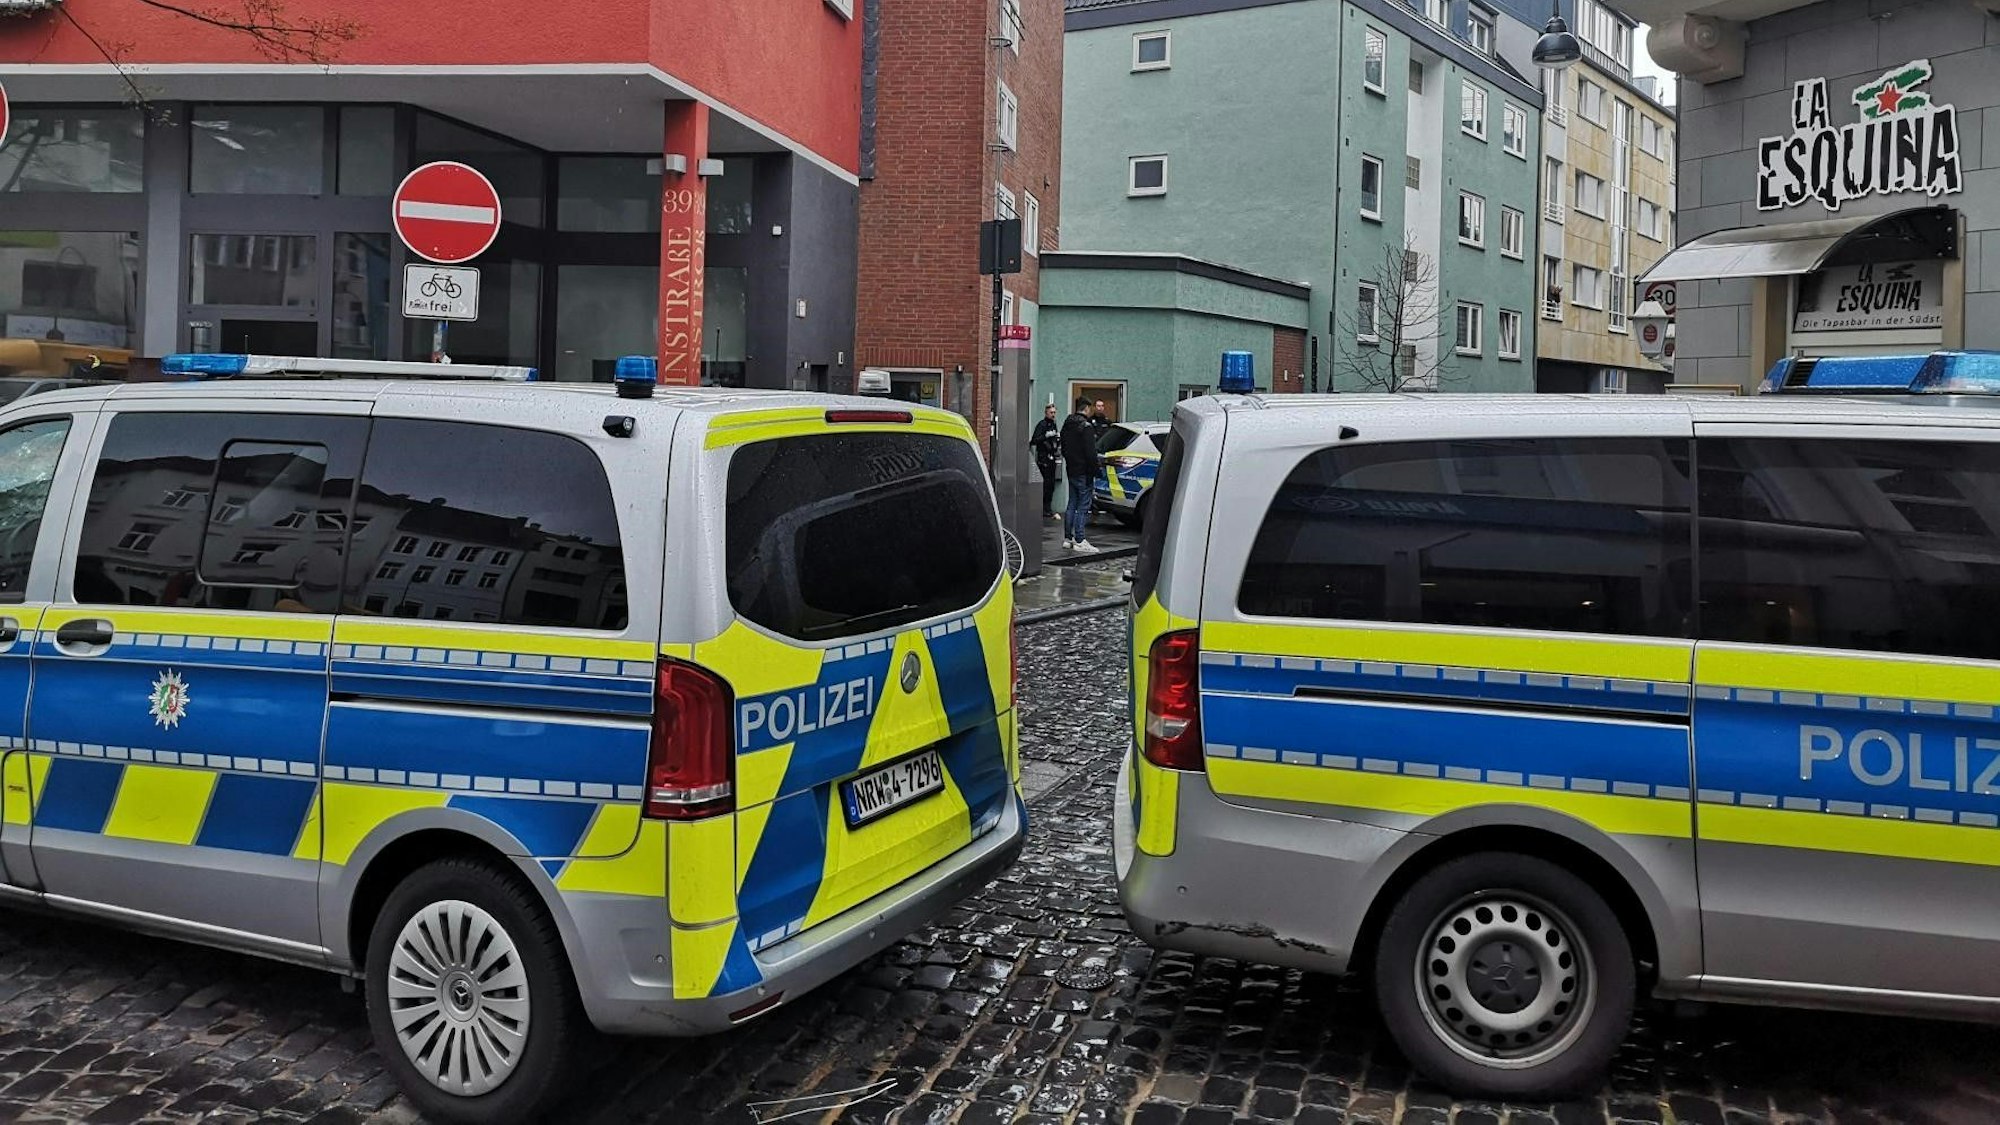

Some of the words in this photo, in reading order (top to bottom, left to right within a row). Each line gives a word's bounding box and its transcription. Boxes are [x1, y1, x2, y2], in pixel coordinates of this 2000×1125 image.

[1795, 82, 1827, 129] LA
[1759, 109, 1958, 208] ESQUINA
[663, 189, 693, 213] 39
[1857, 263, 1875, 283] LA
[430, 300, 452, 312] frei
[1653, 289, 1676, 306] 30
[1836, 280, 1923, 315] ESQUINA
[1822, 317, 1868, 328] Tapasbar
[1871, 317, 1882, 326] in
[1886, 316, 1905, 325] der
[1908, 314, 1943, 324] Südst
[740, 675, 874, 748] POLIZEI
[1799, 724, 2000, 796] POLIZ
[854, 773, 886, 815] NRW
[891, 752, 940, 798] 4-7296
